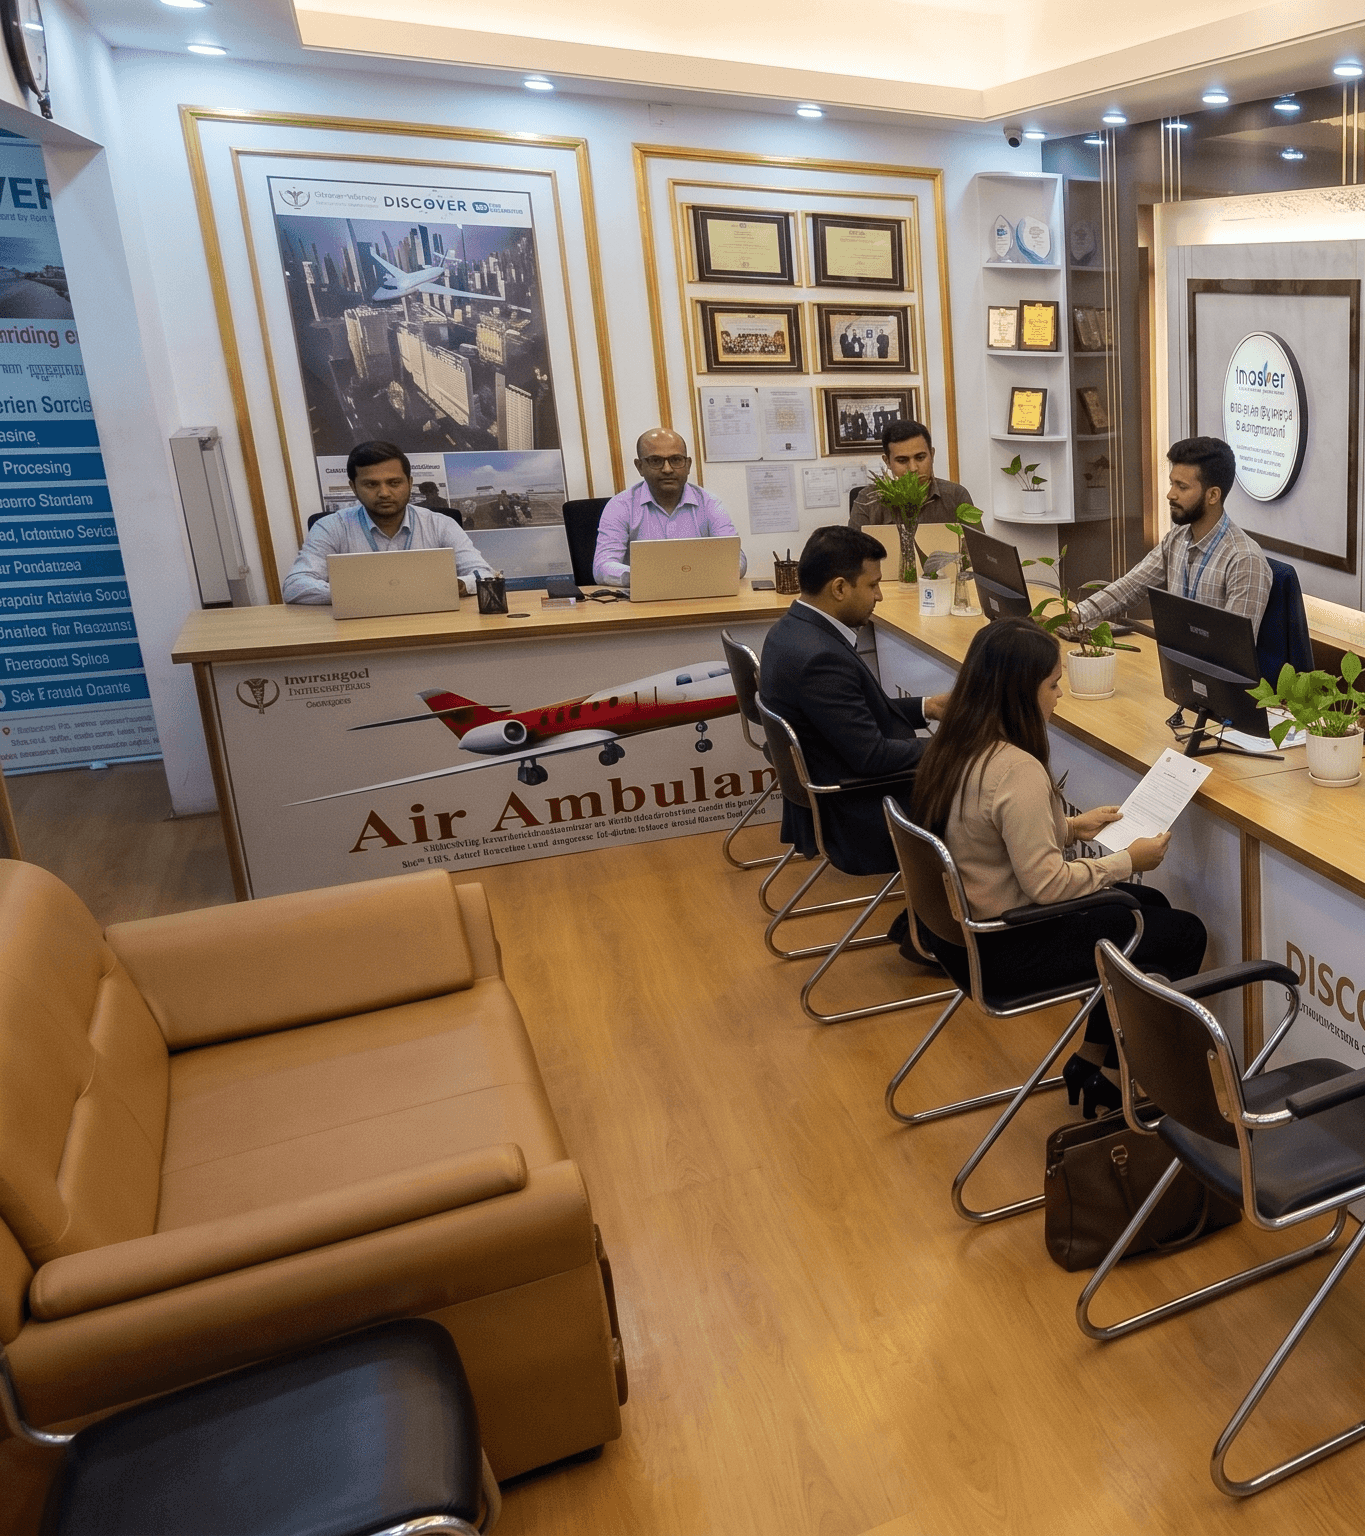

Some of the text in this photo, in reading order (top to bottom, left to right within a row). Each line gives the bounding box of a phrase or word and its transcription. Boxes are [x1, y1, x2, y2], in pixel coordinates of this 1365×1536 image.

[384, 196, 467, 212] DISCOVER
[3, 460, 72, 476] Procesing
[349, 803, 467, 853] Air
